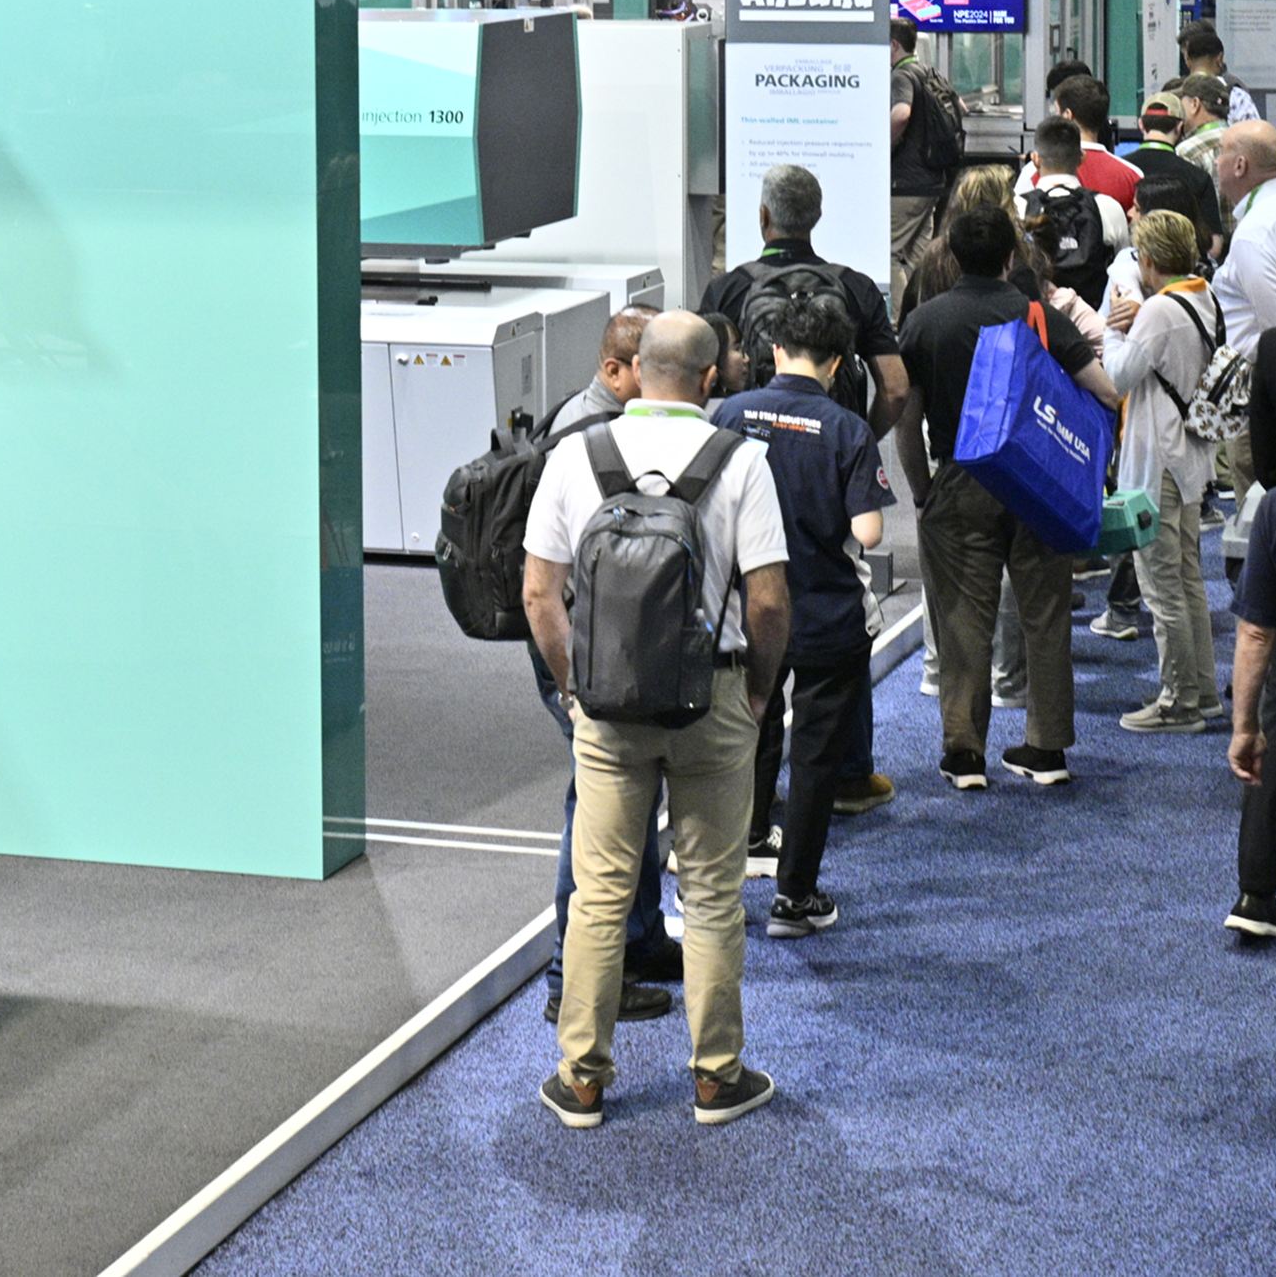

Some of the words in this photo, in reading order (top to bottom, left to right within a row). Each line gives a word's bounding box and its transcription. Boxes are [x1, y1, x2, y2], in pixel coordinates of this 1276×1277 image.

[755, 73, 860, 88] PACKAGING
[361, 108, 422, 126] injection
[429, 109, 464, 124] 1300
[1033, 395, 1057, 424] LS
